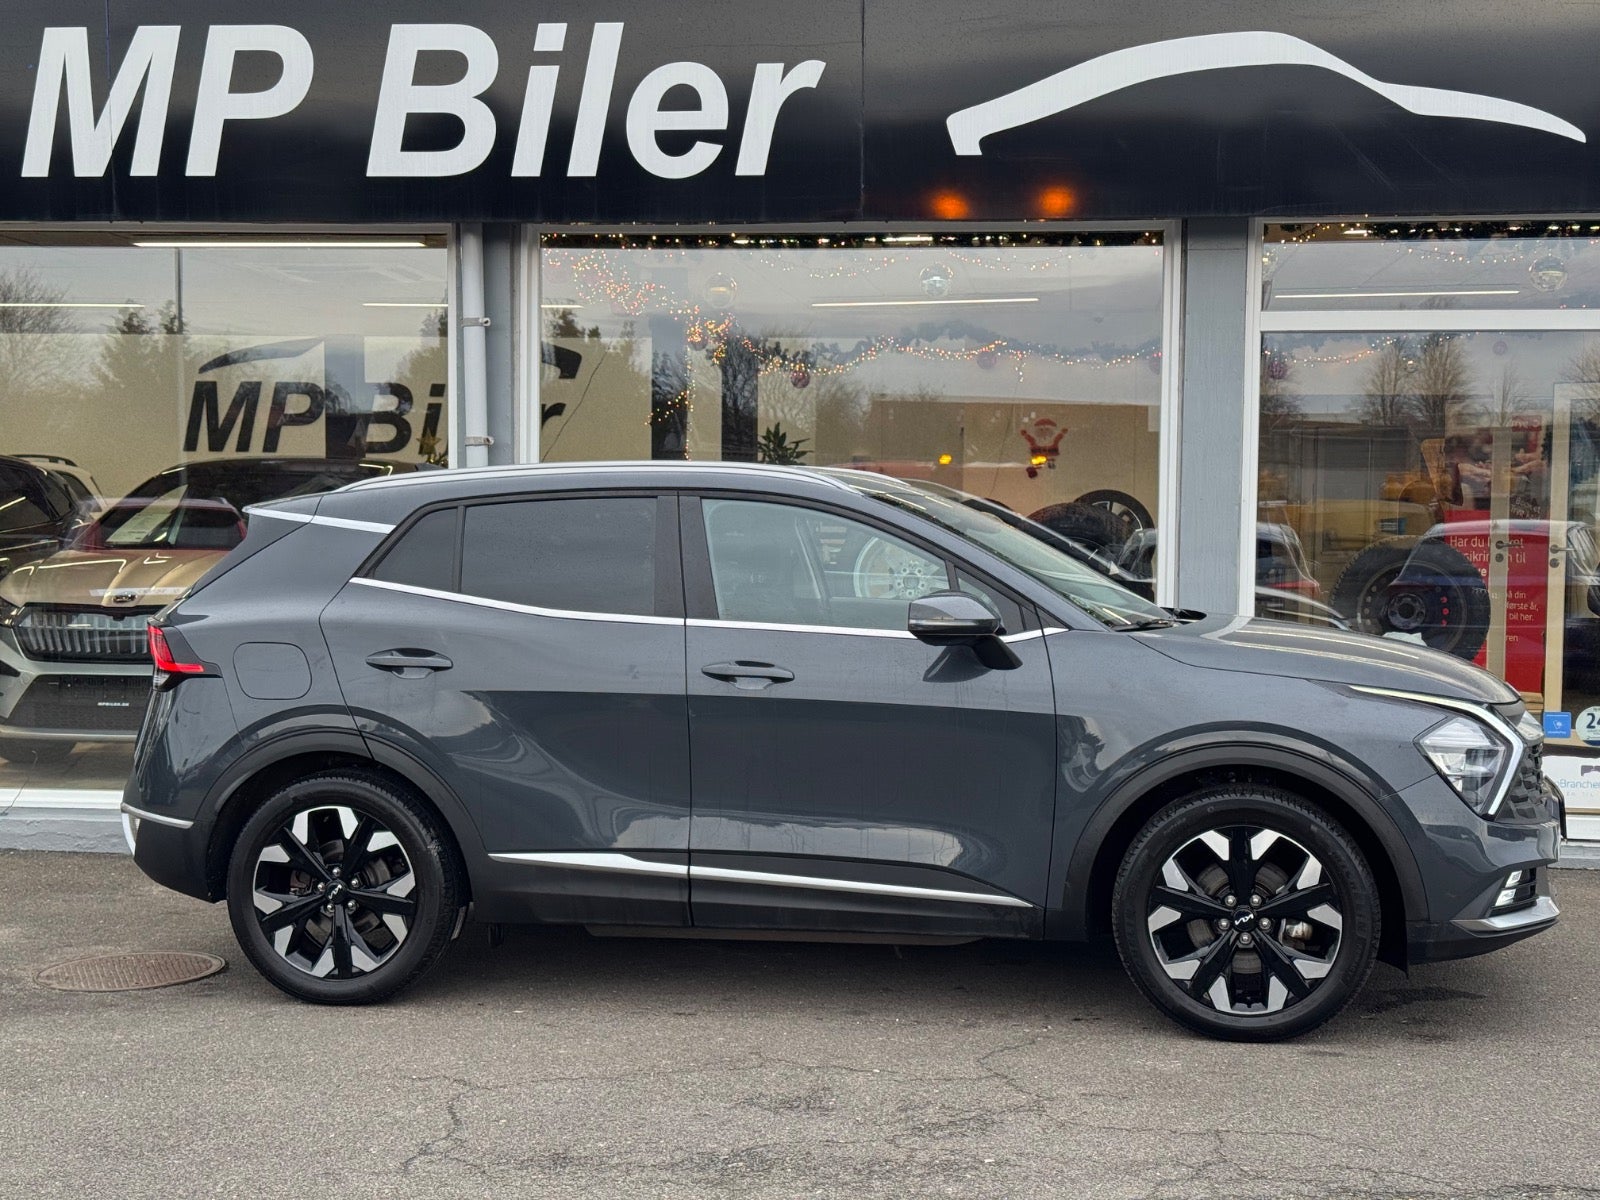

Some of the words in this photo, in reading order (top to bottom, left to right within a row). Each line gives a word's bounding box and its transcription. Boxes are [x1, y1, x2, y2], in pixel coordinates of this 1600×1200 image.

[21, 24, 315, 178] MP
[366, 22, 826, 180] Biler
[183, 380, 325, 453] MP
[1450, 536, 1468, 549] Har
[1470, 536, 1485, 548] du
[1515, 552, 1526, 564] til
